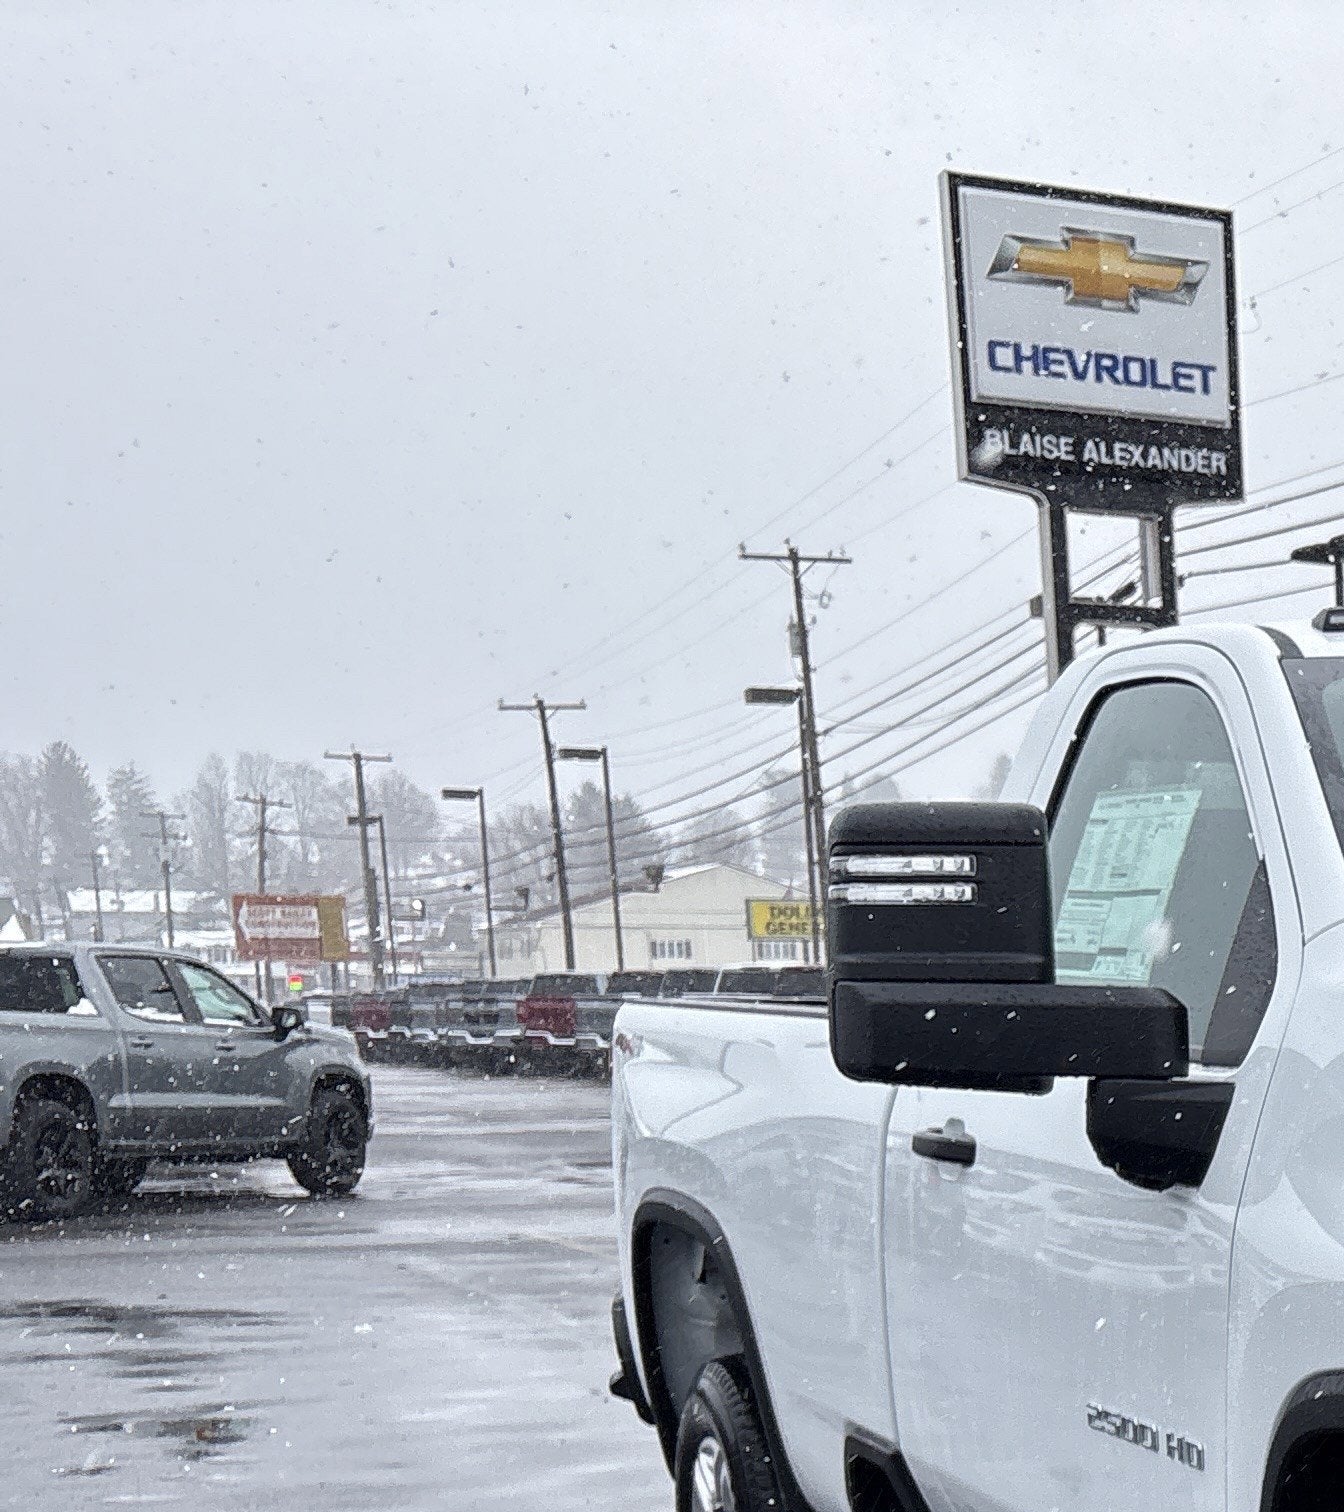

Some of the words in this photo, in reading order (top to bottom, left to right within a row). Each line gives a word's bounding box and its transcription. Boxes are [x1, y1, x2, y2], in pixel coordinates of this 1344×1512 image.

[987, 340, 1217, 396] CHEVROLET
[984, 428, 1076, 461] BLAISE
[1082, 440, 1227, 475] ALEXANDER
[1166, 1432, 1205, 1472] HD
